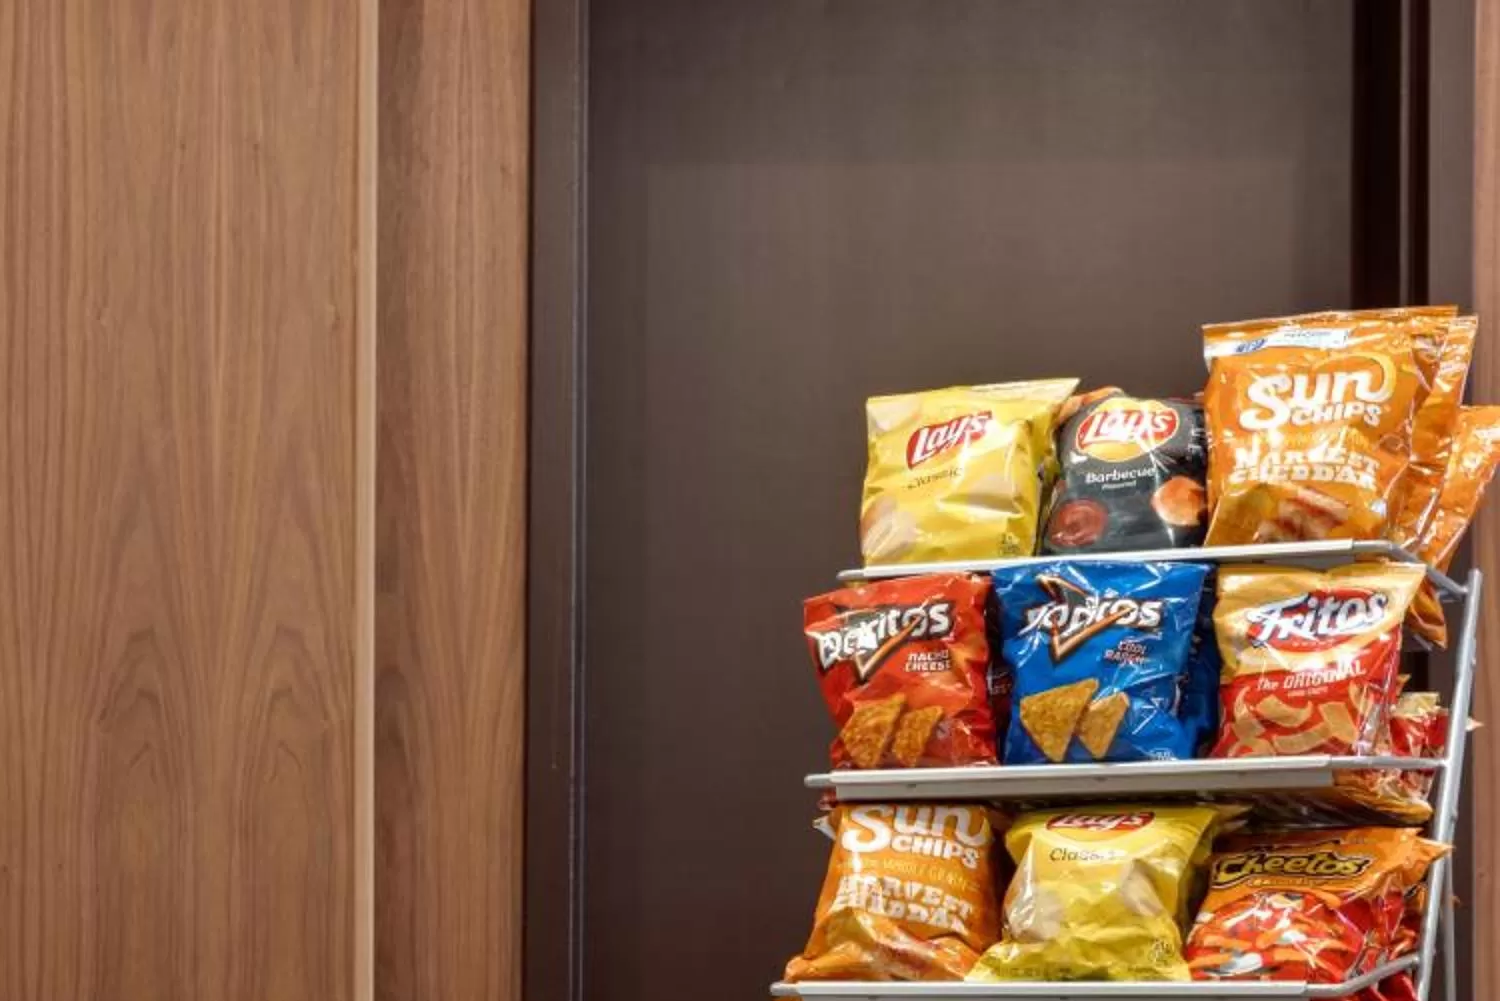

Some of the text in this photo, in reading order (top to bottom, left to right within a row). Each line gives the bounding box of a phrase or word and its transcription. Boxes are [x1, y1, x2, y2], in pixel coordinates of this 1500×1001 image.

[1239, 364, 1395, 430] Sun
[1291, 400, 1383, 427] CHIPS
[1084, 406, 1173, 448] Lay's
[1245, 592, 1389, 648] Fritos
[842, 804, 988, 852] Sun
[891, 835, 979, 869] CHIPS
[1218, 851, 1367, 885] Cheetos
